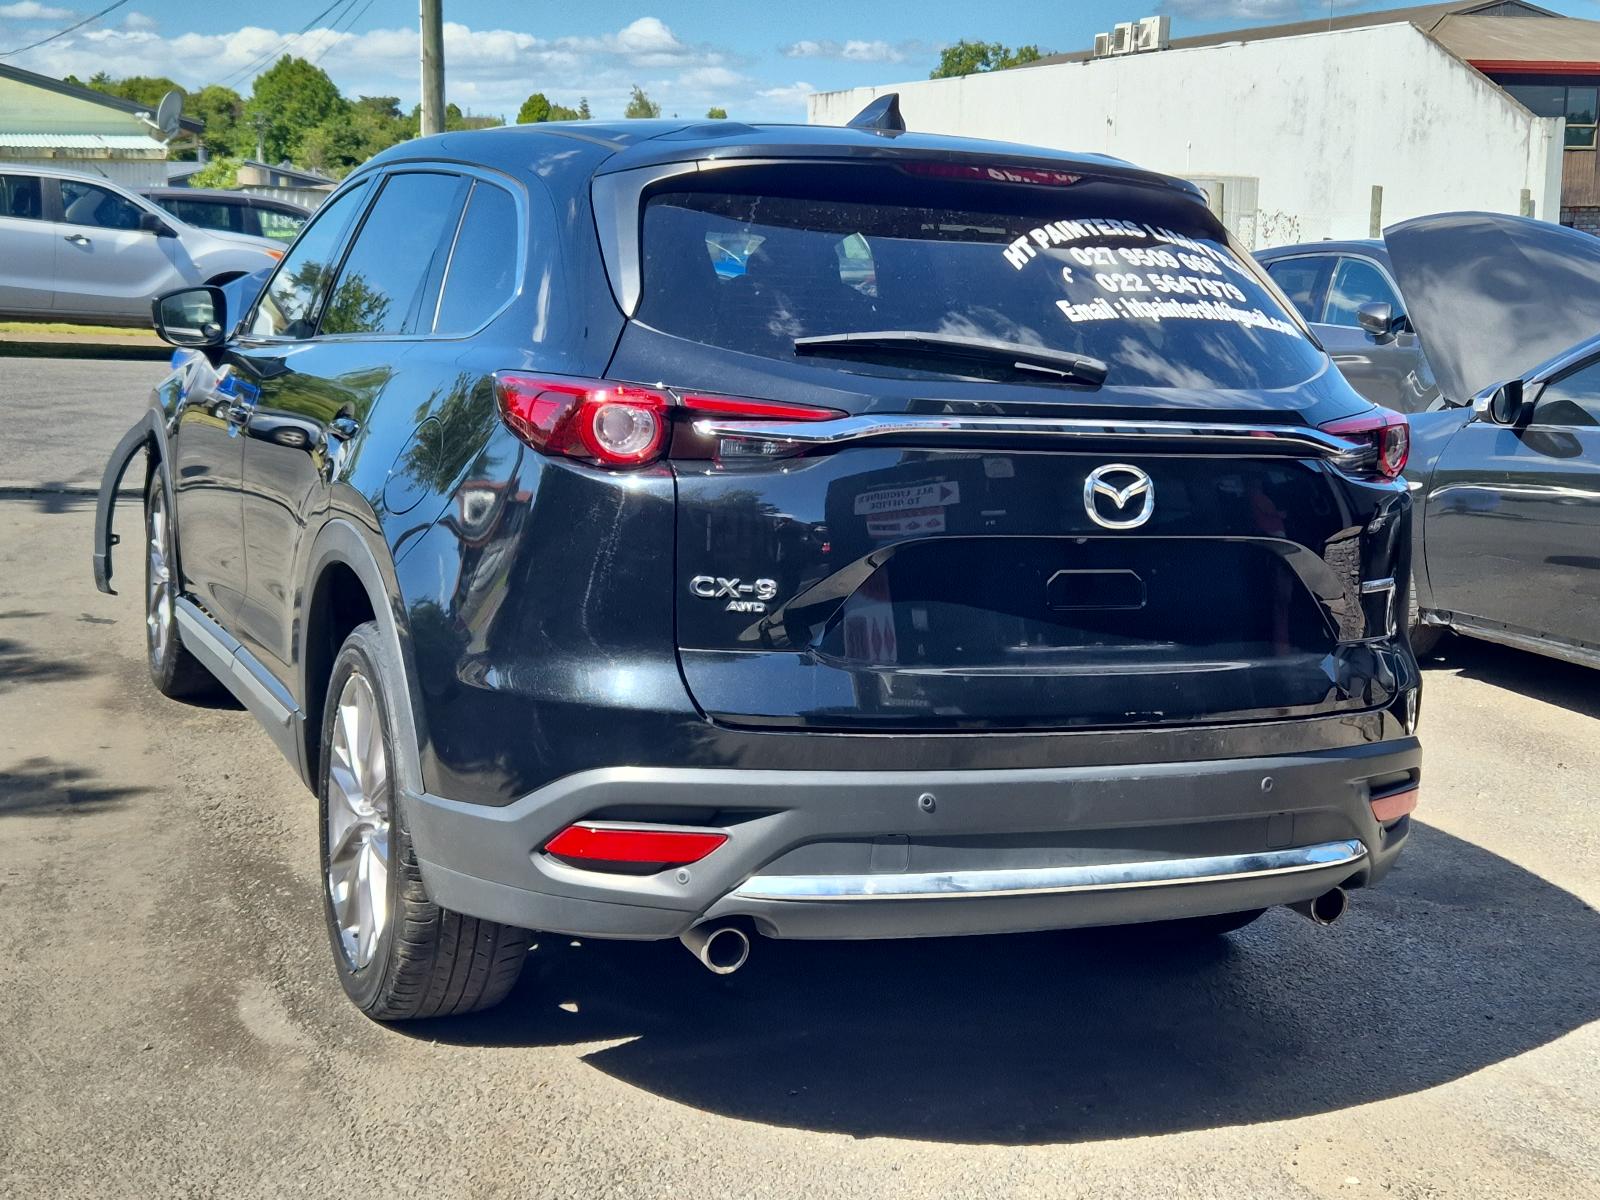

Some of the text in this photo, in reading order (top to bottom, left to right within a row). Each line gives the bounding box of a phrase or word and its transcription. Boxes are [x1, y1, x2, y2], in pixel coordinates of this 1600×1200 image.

[1003, 235, 1036, 271] HT
[1029, 218, 1147, 249] PAINTERS
[1070, 247, 1222, 275] 027 9509 668
[1095, 273, 1246, 302] 022 5647979
[1055, 297, 1119, 322] Email
[689, 575, 778, 600] CX-9
[726, 600, 766, 612] AWD
